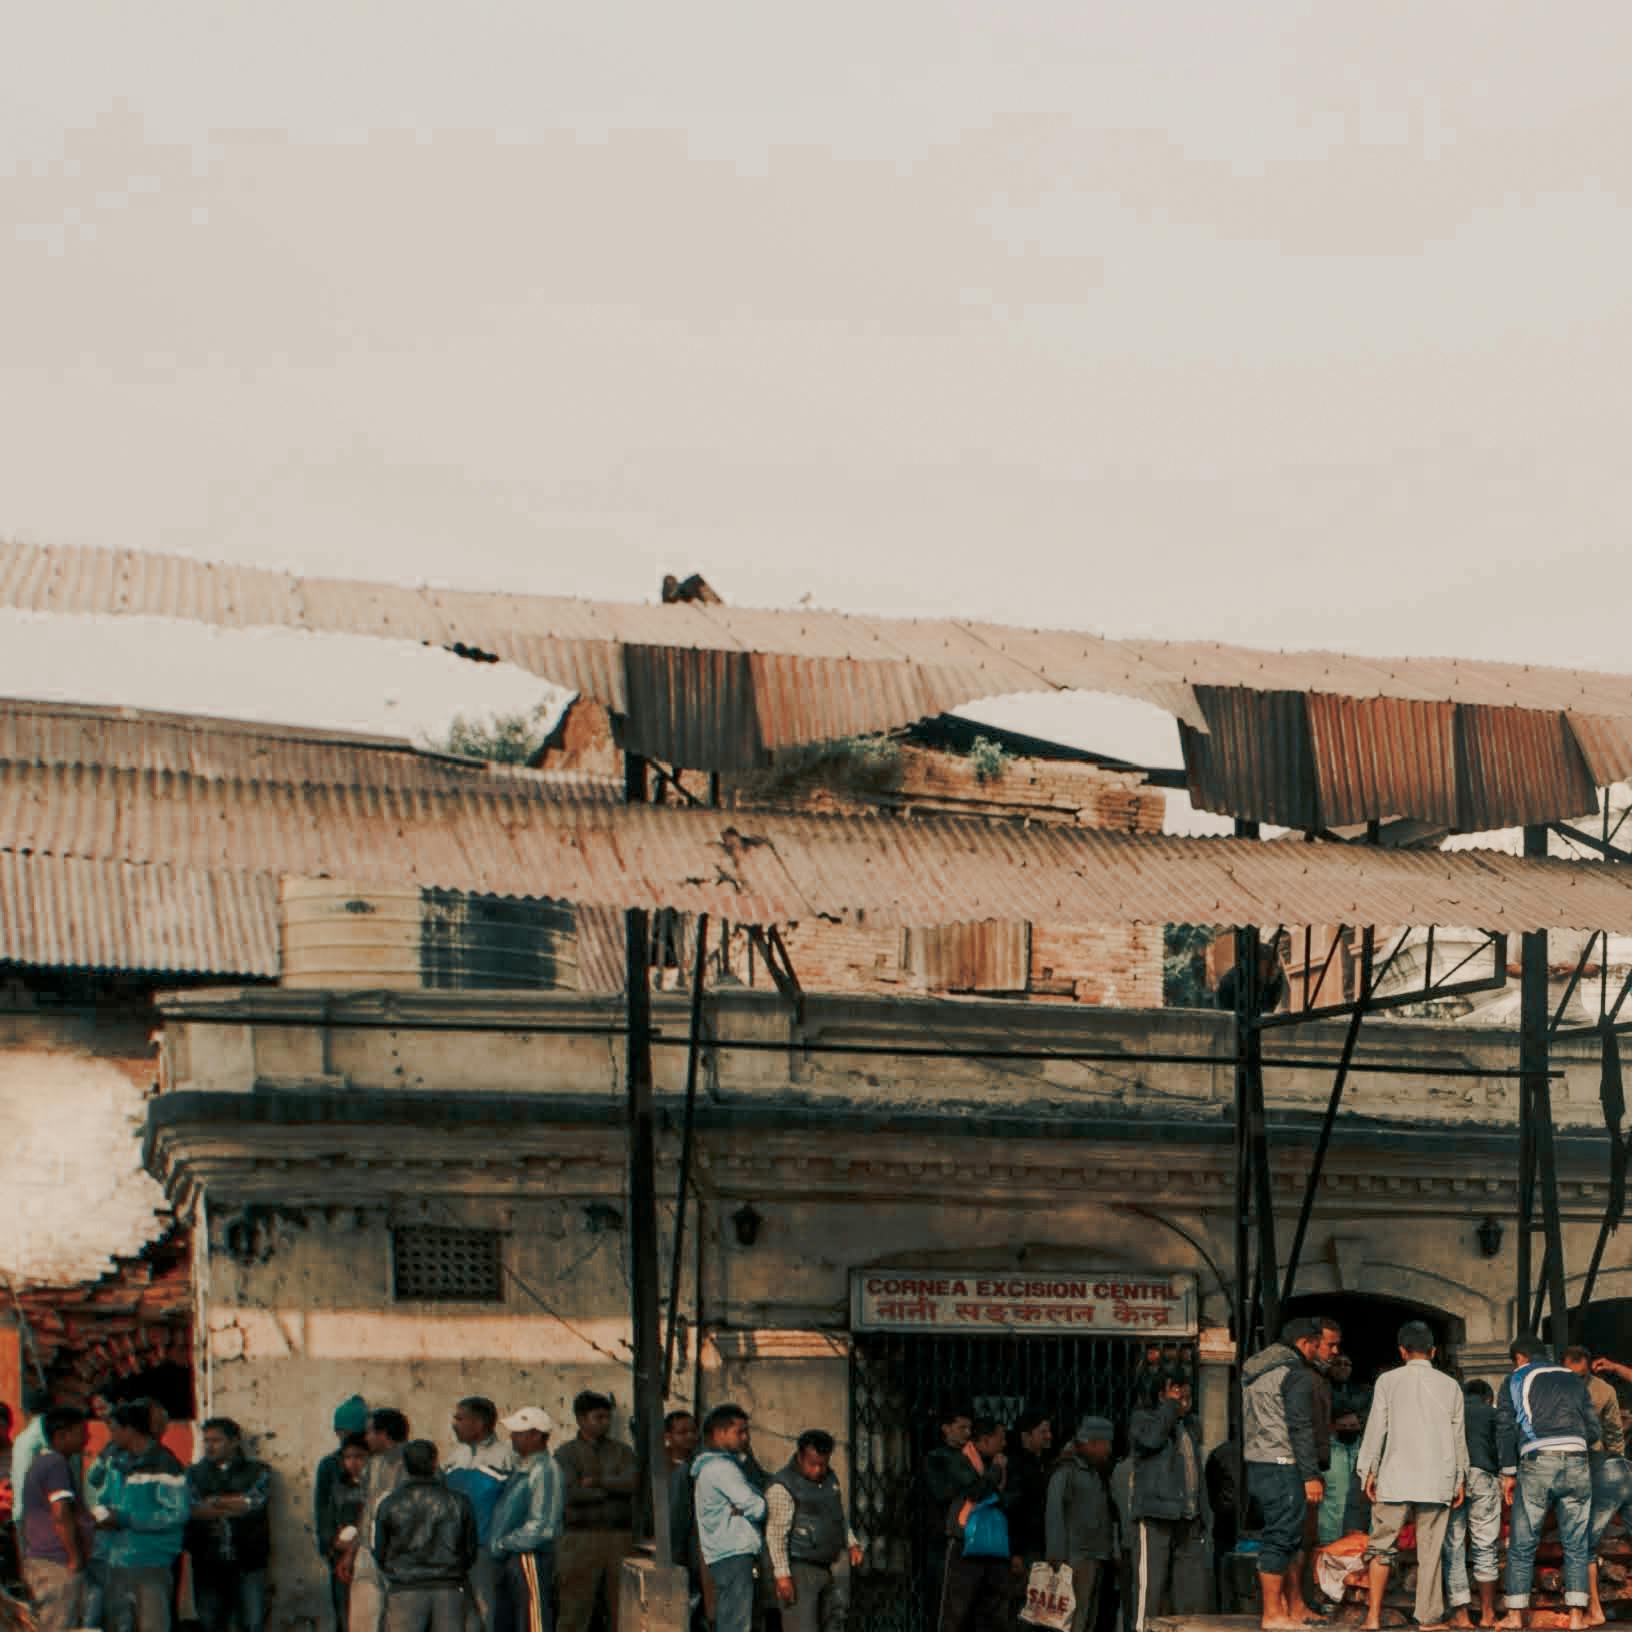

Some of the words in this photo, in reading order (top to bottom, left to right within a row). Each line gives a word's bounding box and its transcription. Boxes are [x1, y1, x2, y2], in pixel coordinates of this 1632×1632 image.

[866, 1280, 968, 1296] CORNEA
[976, 1280, 1087, 1299] EXCISION
[1029, 1588, 1070, 1614] SALE
